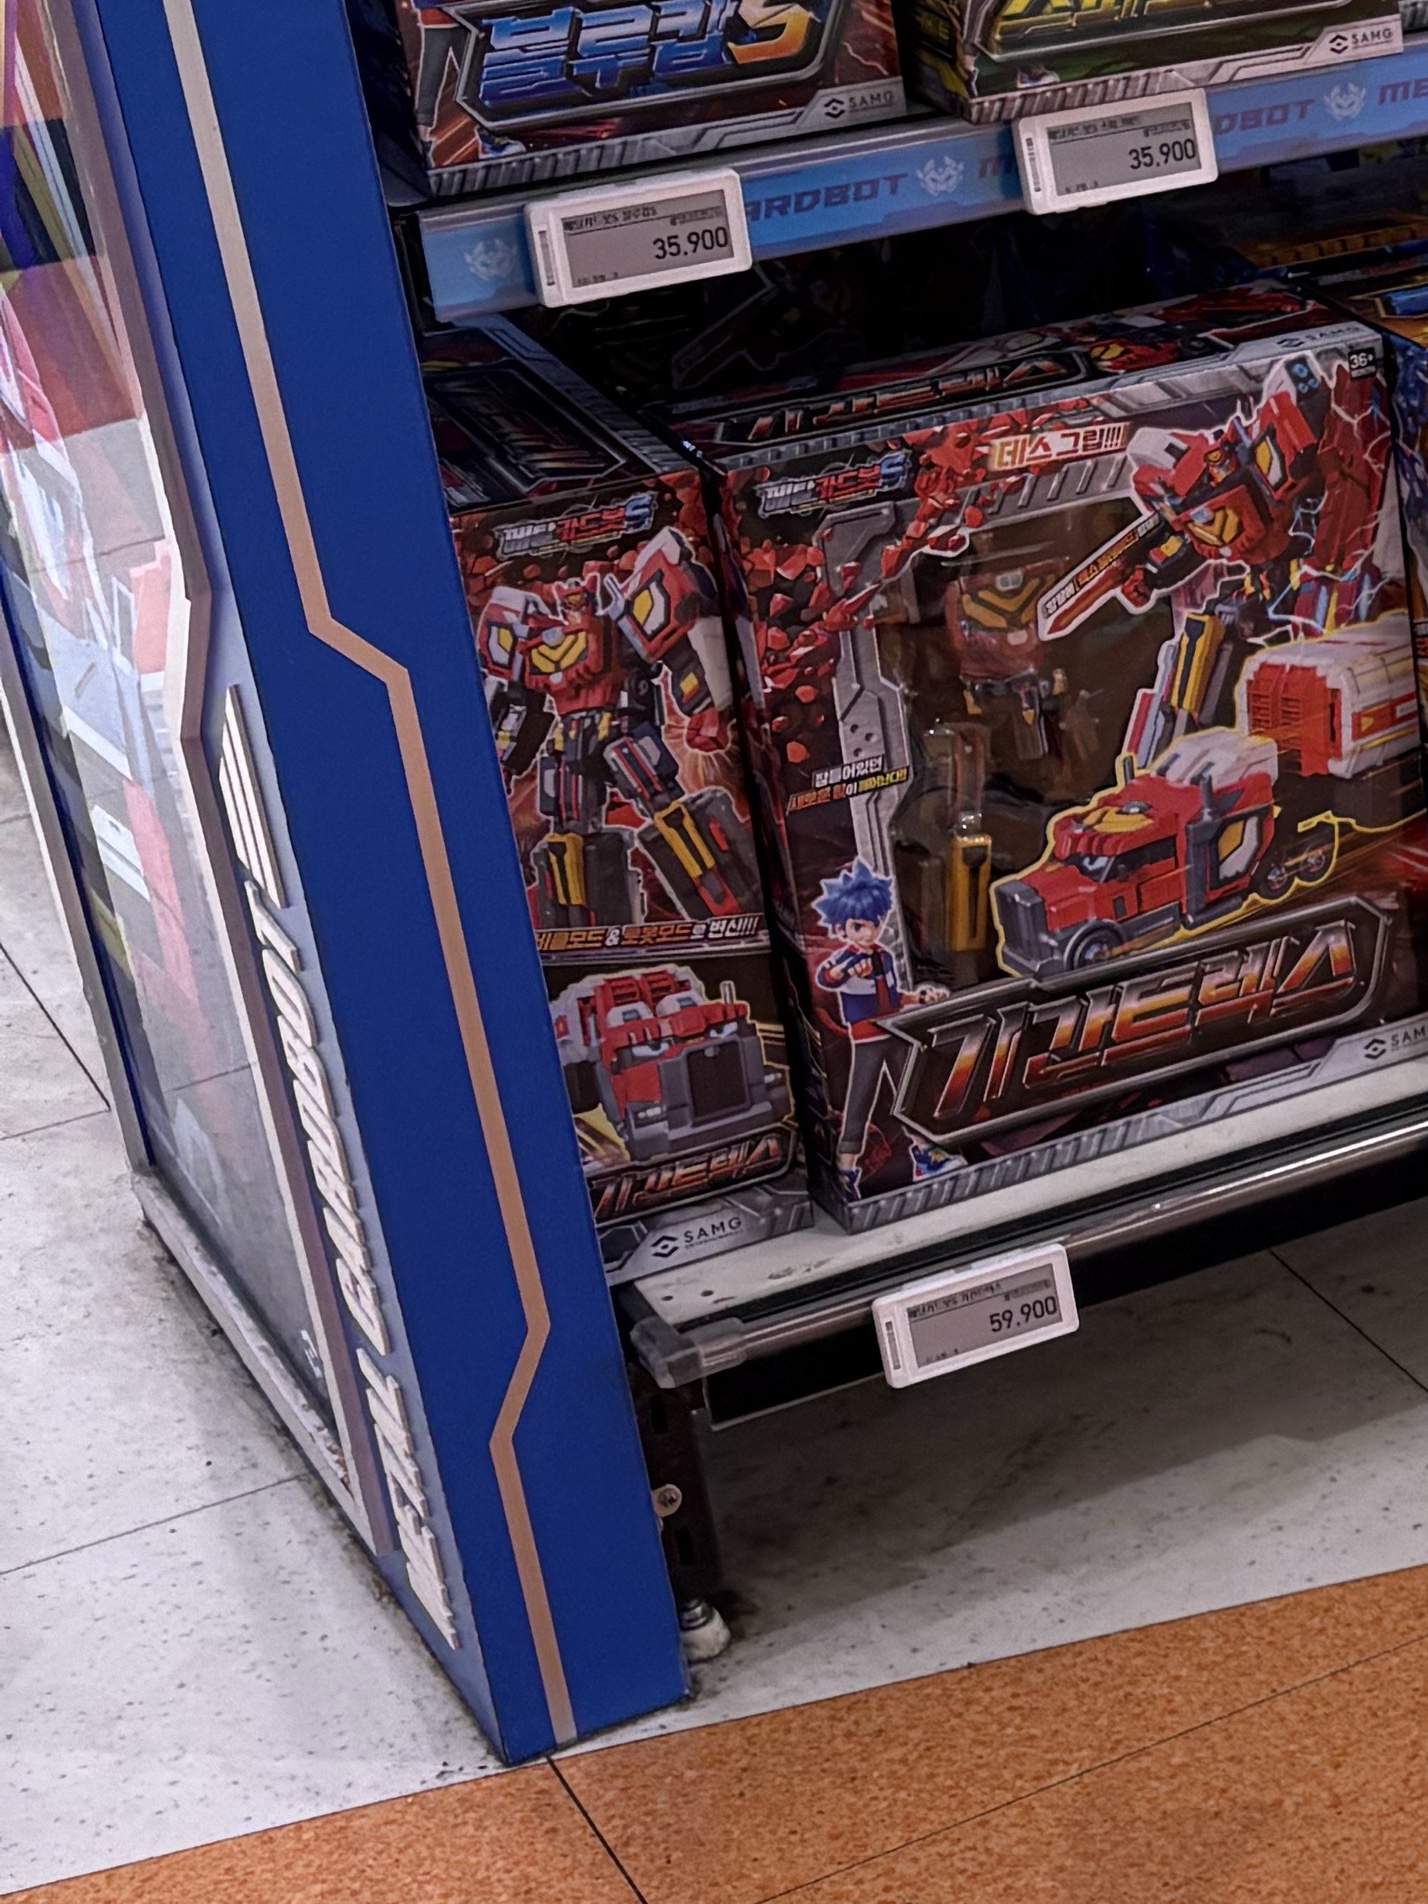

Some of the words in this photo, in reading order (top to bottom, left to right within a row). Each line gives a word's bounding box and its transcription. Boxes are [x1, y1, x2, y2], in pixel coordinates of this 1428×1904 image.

[1350, 25, 1393, 47] SAMG
[996, 435, 1053, 469] 데스
[683, 1215, 743, 1244] SAMG
